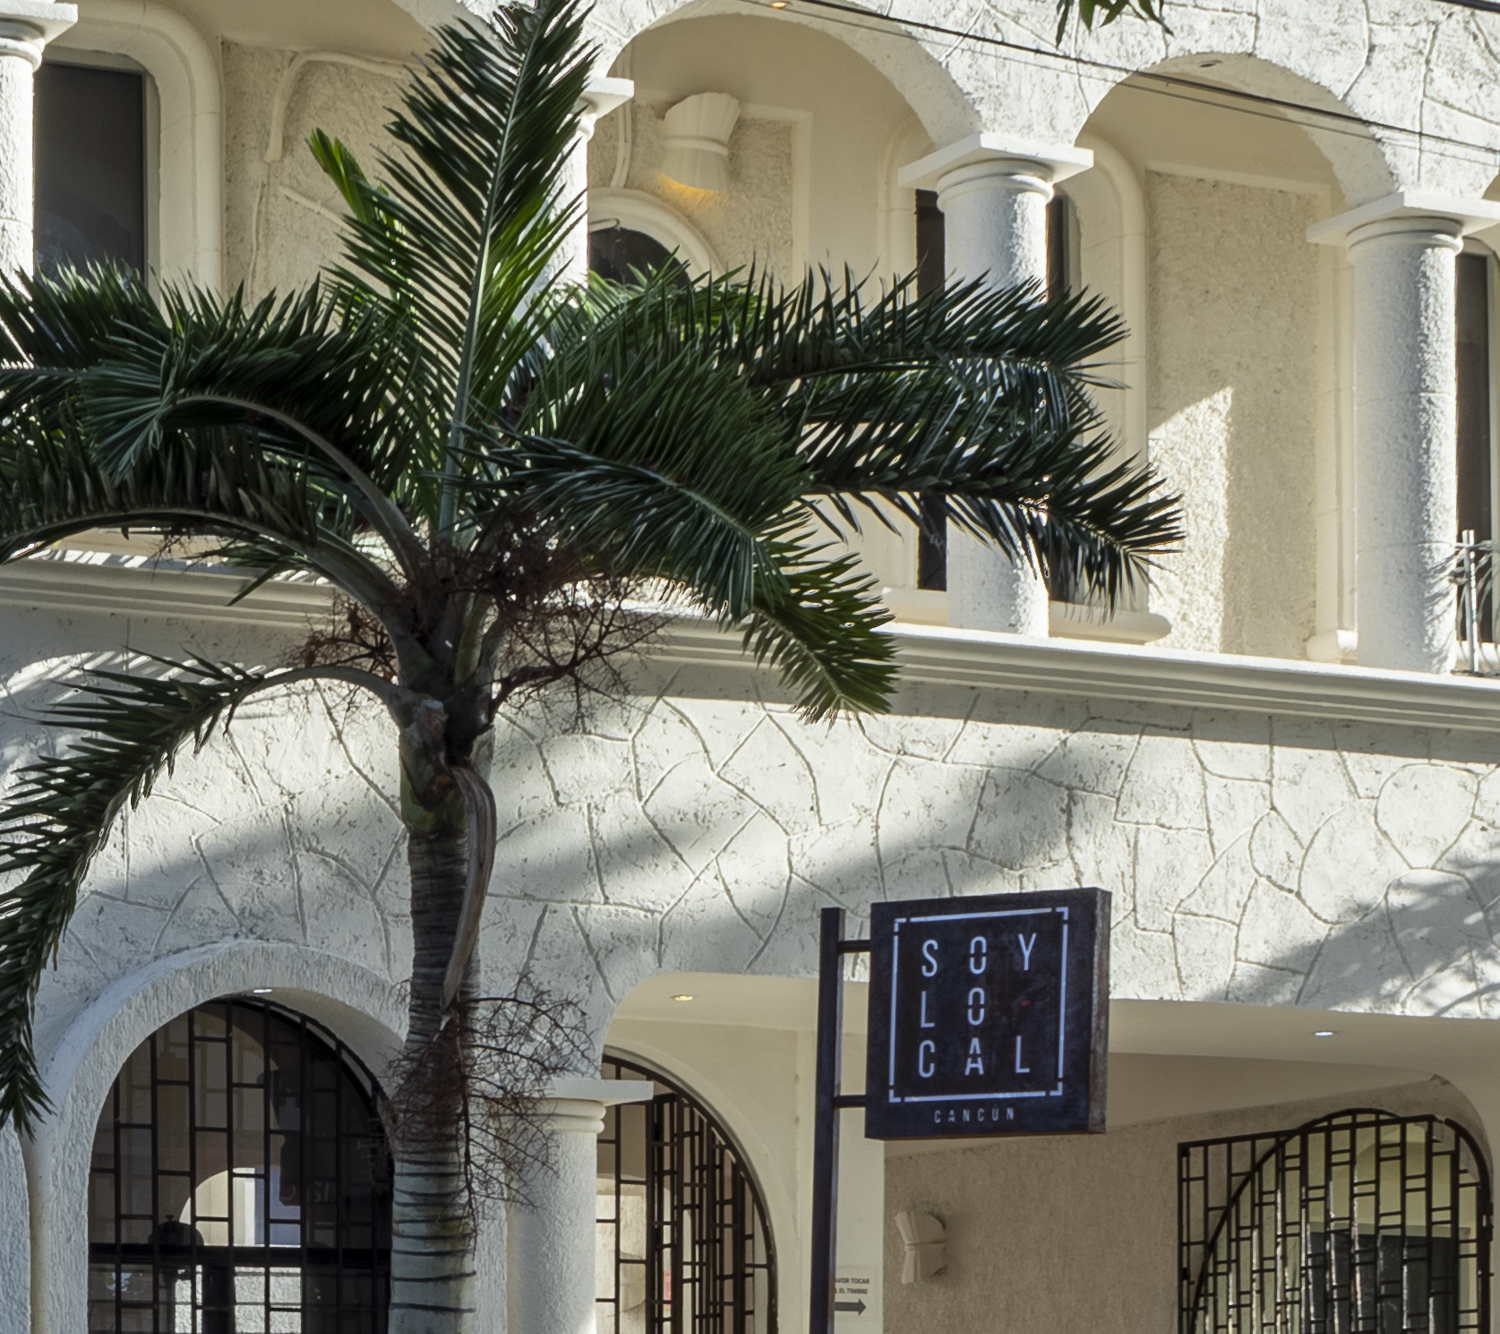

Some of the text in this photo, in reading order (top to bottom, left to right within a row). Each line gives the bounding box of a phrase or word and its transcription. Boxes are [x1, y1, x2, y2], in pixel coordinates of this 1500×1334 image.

[922, 933, 1037, 977] SOY
[918, 1035, 1030, 1078] CAL
[934, 1104, 1014, 1123] CANCÚN
